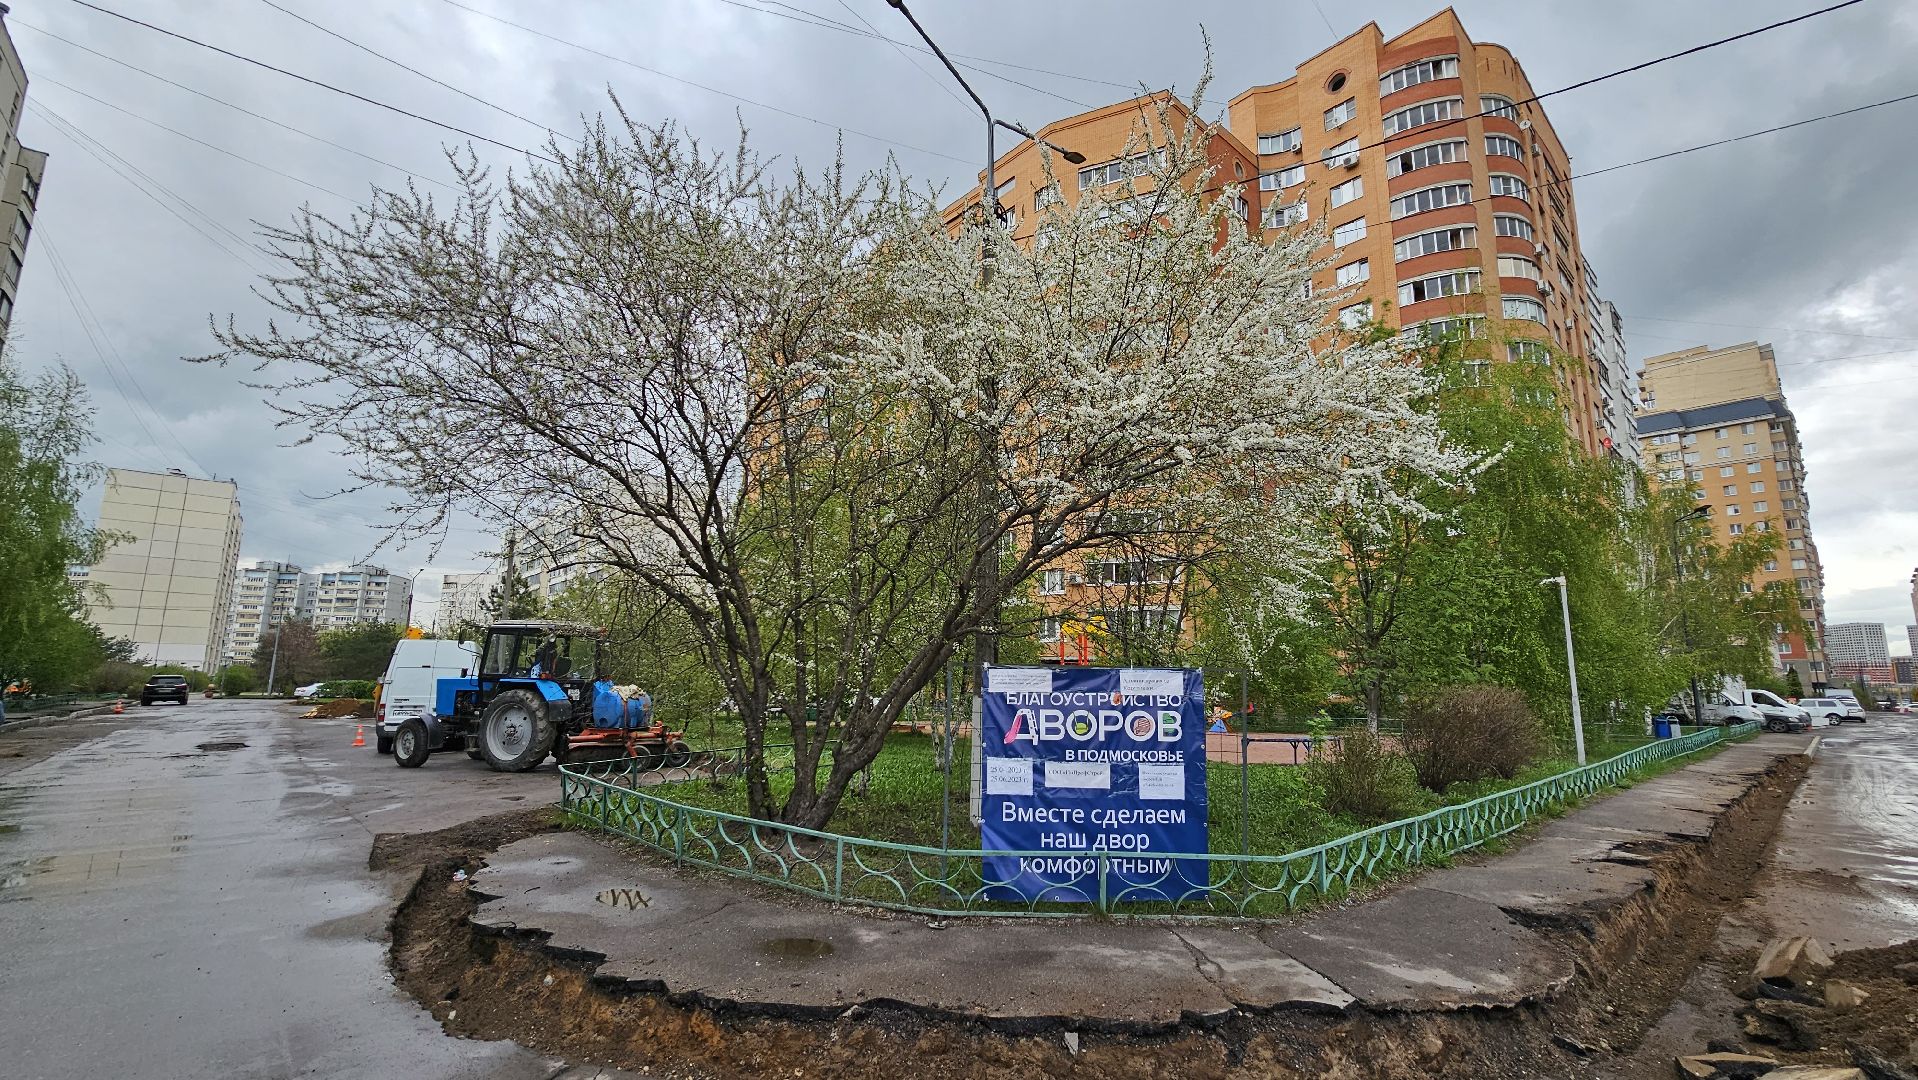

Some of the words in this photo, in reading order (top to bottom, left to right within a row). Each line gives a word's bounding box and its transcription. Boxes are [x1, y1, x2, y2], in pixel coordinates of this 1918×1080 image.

[1003, 708, 1183, 746] ДВОРОВ
[1065, 750, 1076, 761] В
[1077, 750, 1184, 763] ПОДМОСКОВЬЕ
[1002, 801, 1085, 823] Вместе
[1090, 808, 1186, 828] сделаем
[1041, 832, 1087, 848] наш
[1092, 833, 1150, 853] двор
